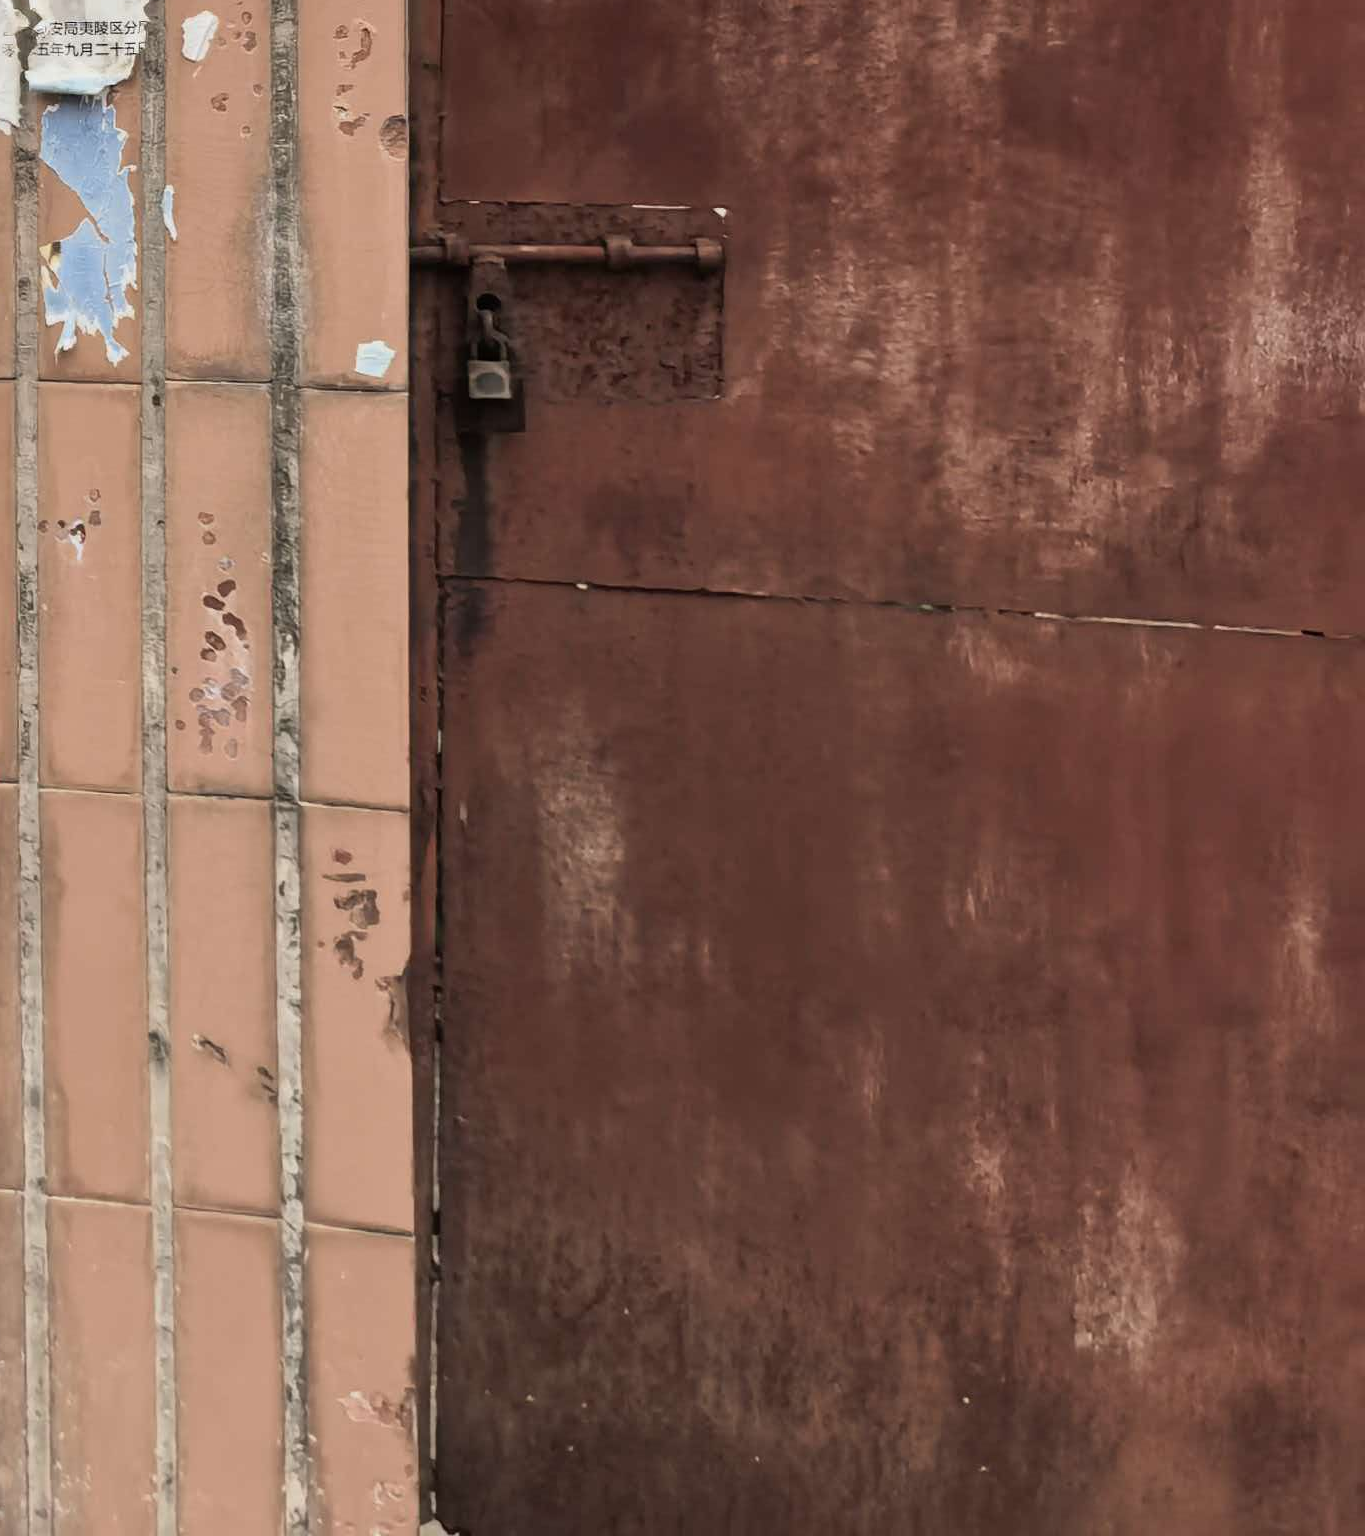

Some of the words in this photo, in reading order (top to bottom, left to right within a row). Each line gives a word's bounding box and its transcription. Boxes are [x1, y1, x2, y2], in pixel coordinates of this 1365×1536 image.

[37, 20, 146, 36] 安局夷陵区分
[33, 41, 145, 57] 五年九月二十五
